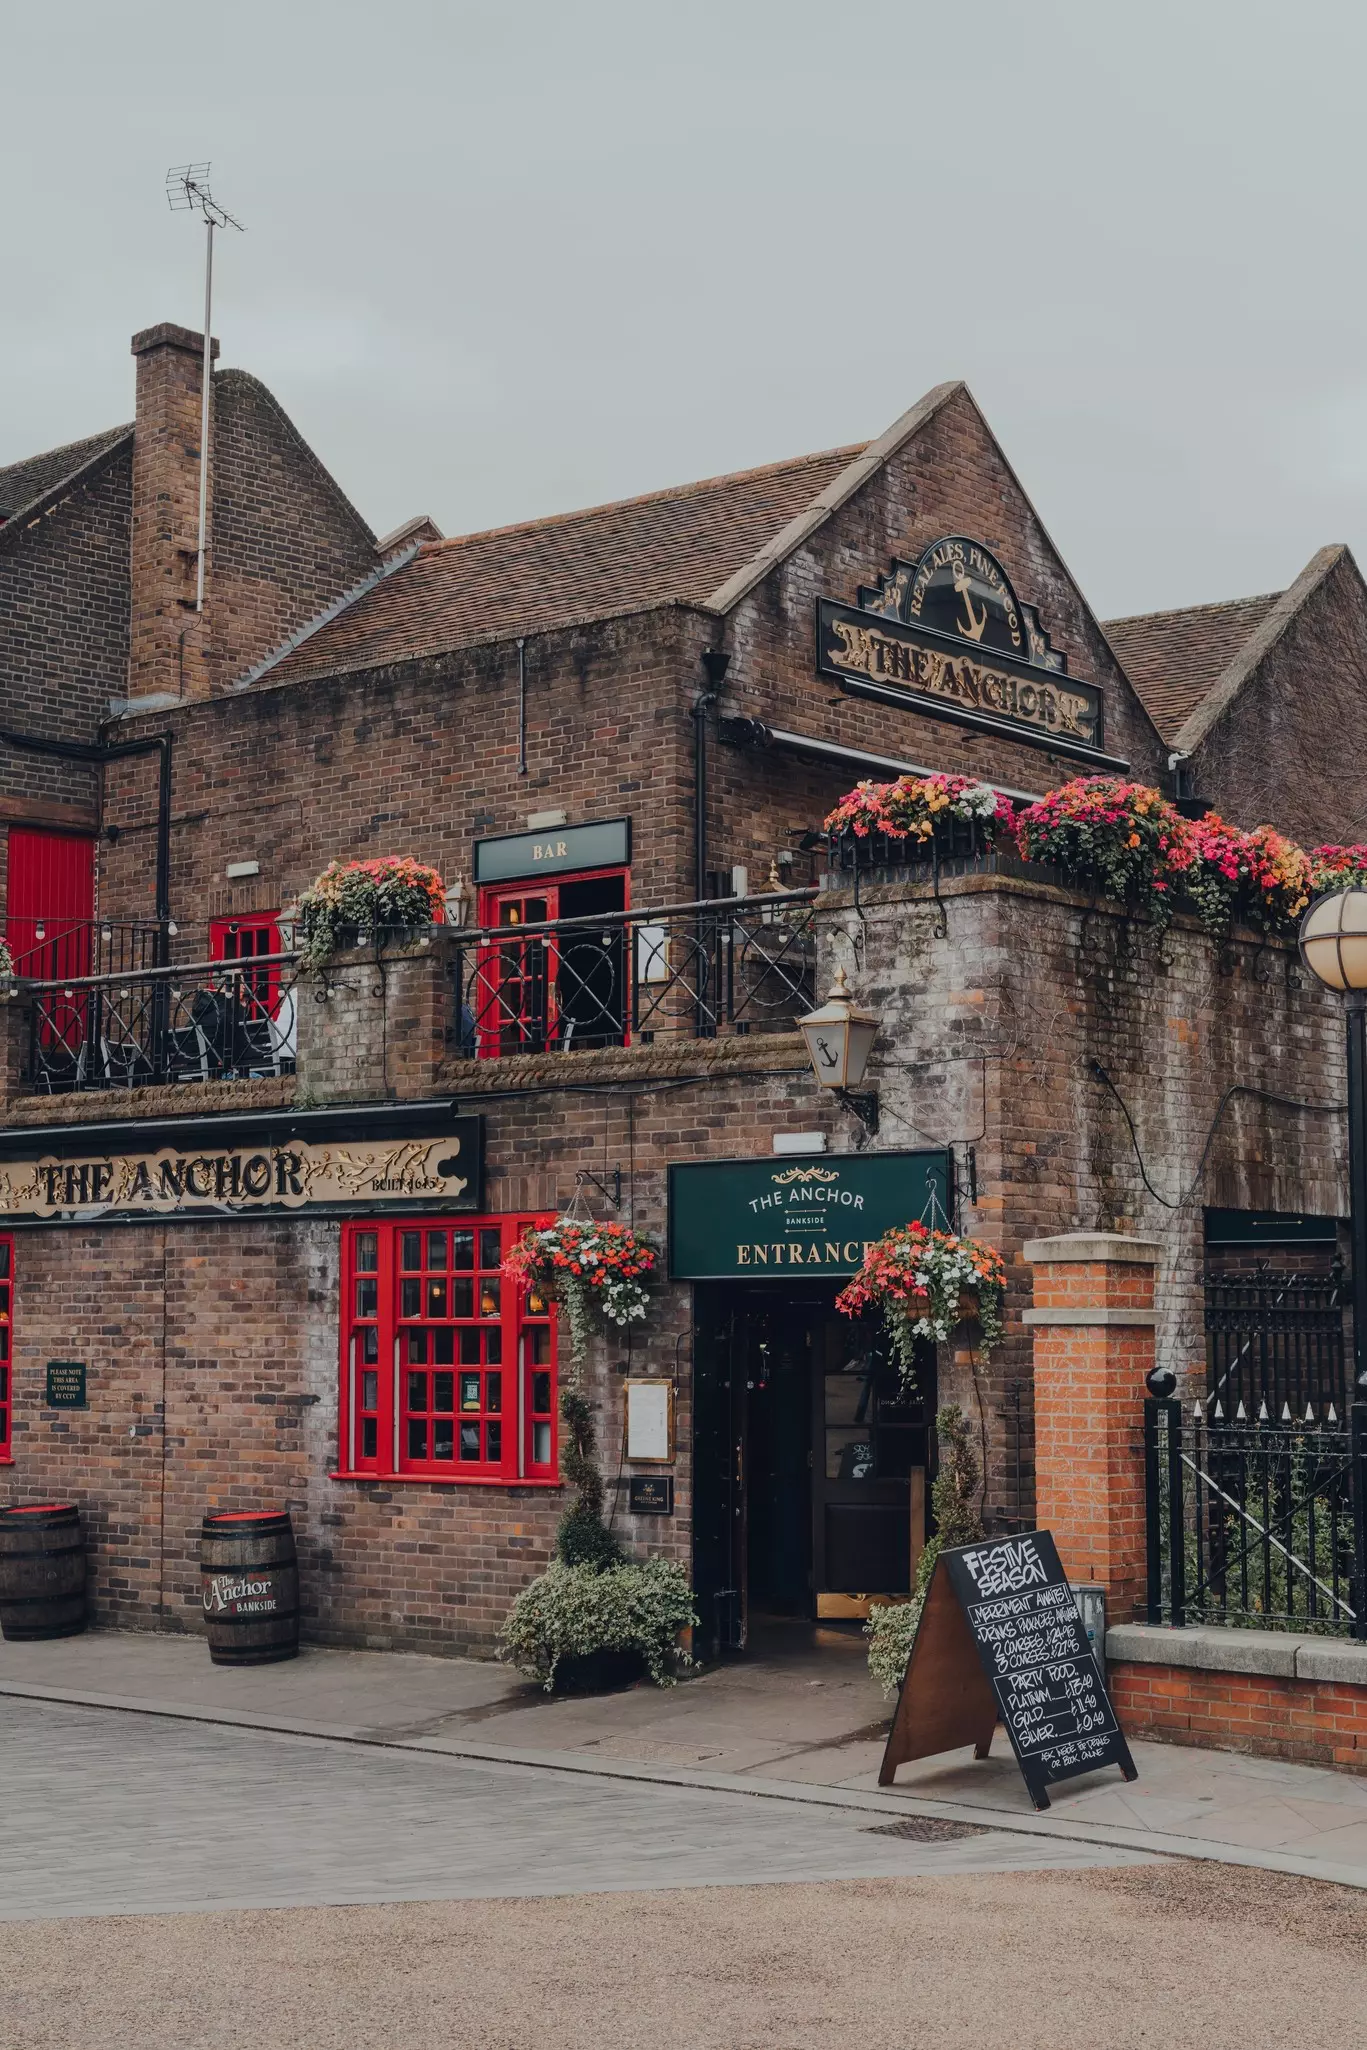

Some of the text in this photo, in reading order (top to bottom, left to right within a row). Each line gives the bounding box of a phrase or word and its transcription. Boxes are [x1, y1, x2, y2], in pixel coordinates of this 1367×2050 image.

[911, 544, 1021, 647] REAL ALES, FINE FOOD
[871, 635, 1056, 725] THE ANCHOR
[532, 841, 568, 860] BAR
[39, 1150, 304, 1205] THE ANCHOR
[372, 1179, 404, 1191] BUILT
[749, 1188, 864, 1214] THE ANCHOR
[786, 1216, 824, 1224] BANKSIDE
[962, 1539, 1039, 1580] FESTIVE
[219, 1575, 234, 1587] The
[977, 1559, 1048, 1597] SEASON
[203, 1577, 272, 1611] Anchor
[237, 1600, 277, 1612] BANKSIDE
[1016, 1611, 1055, 1634] PACKAGES
[993, 1642, 1004, 1659] 2
[994, 1656, 1009, 1673] 3
[1008, 1669, 1044, 1692] PARTY
[1065, 1674, 1093, 1698] £13.49
[1071, 1694, 1097, 1716] £11.49
[1076, 1711, 1105, 1734] £9.49
[1041, 1750, 1055, 1761] ASK
[1087, 1736, 1110, 1749] DETAILS
[1052, 1748, 1104, 1768] OR BOOK ONLINE
